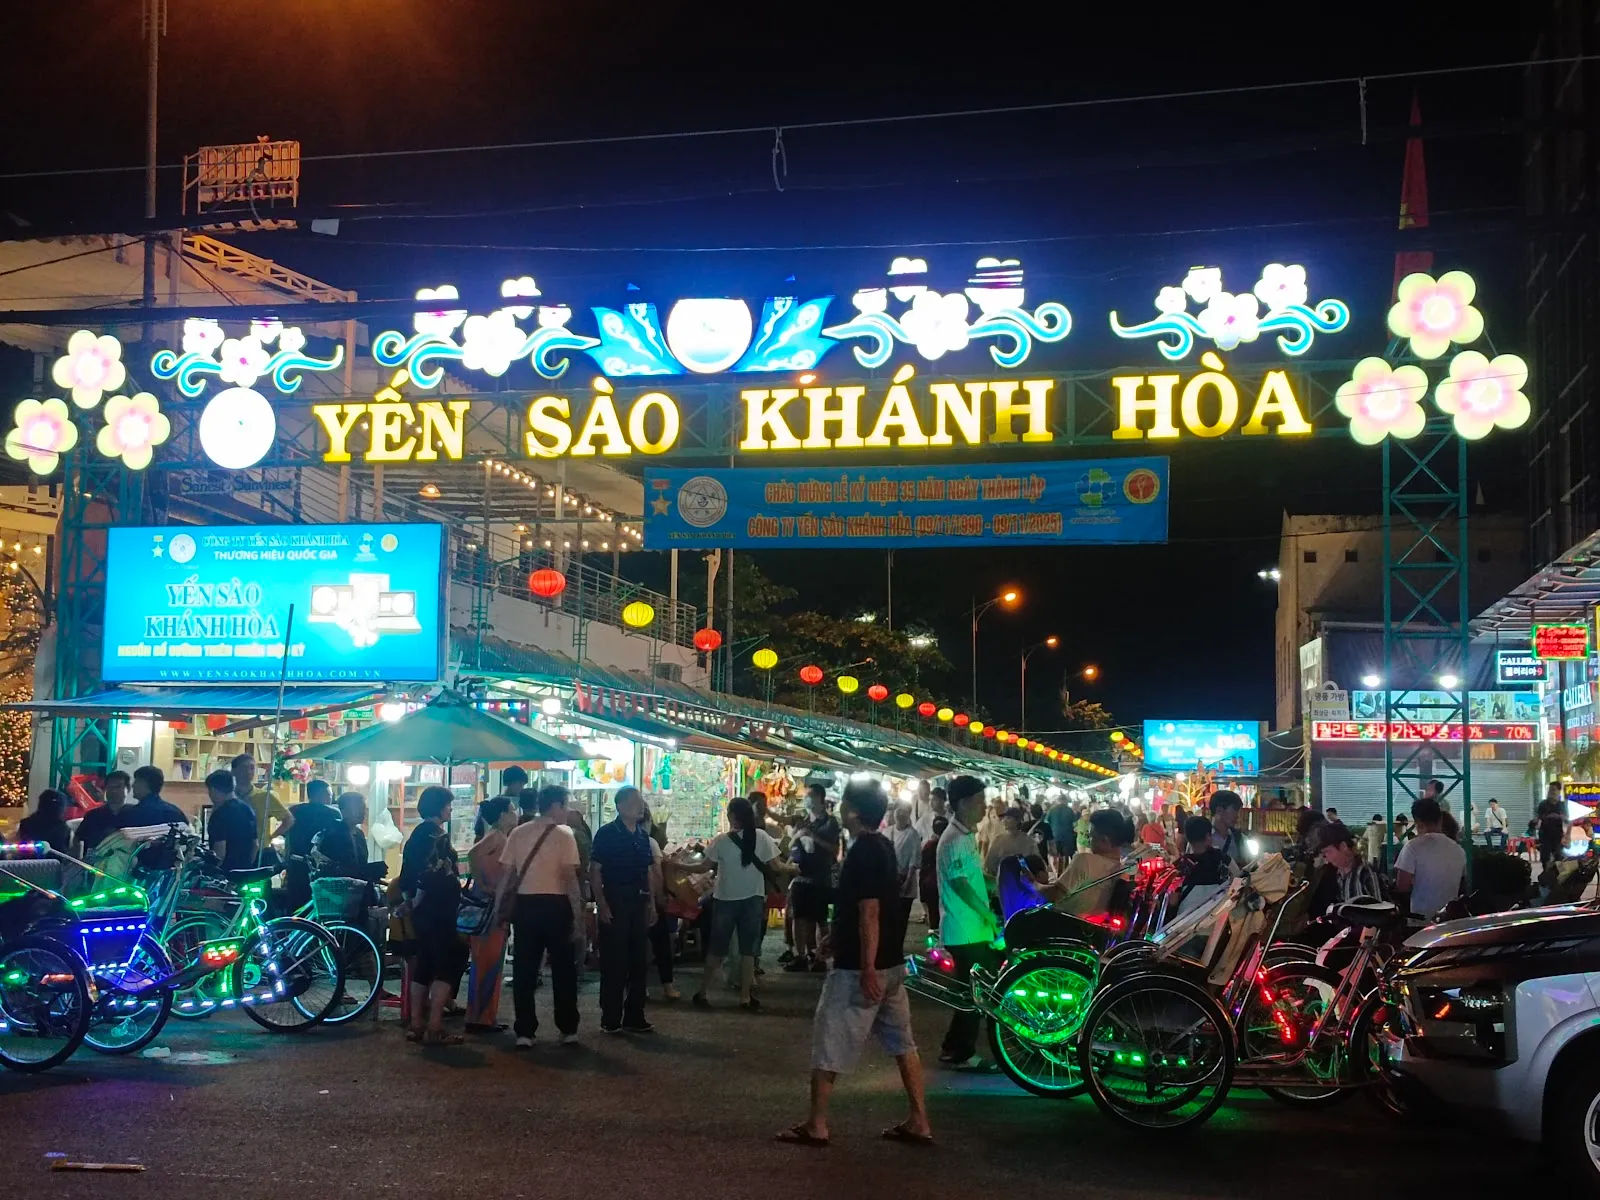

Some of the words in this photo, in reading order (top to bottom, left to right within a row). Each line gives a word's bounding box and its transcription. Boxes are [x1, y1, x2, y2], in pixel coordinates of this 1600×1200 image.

[312, 368, 471, 462] YẾN
[525, 376, 681, 458] SÀO
[738, 364, 1055, 450] KHÁNH
[1110, 351, 1313, 441] HÒA
[764, 479, 795, 504] CHÀO
[798, 480, 832, 504] MỪNG
[833, 472, 848, 503] LỄ
[849, 474, 866, 503] KỶ
[867, 476, 897, 507] NIỆM
[900, 480, 915, 501] 35
[917, 476, 945, 501] NĂM
[947, 475, 979, 501] NGÀY
[981, 474, 1020, 500] THÀNH
[1022, 473, 1046, 503] LẬP
[748, 512, 779, 537] CÔNG
[781, 517, 795, 537] TY
[796, 512, 819, 537] YẾN
[821, 512, 845, 537] SÀO
[847, 512, 887, 537] KHÁNH
[888, 511, 912, 537] HÒA
[915, 513, 984, 538] (09/11/1990
[992, 512, 1064, 537] 09/11/2025)
[202, 533, 230, 547] CÔNG
[232, 536, 245, 547] TY
[214, 550, 258, 561] THƯƠNG
[287, 548, 317, 561] QUỐC
[319, 549, 338, 560] GIA
[165, 573, 212, 607] YẾN
[215, 576, 262, 607] SÀO
[144, 609, 226, 638] KHÁNH
[230, 612, 280, 638] HÒA
[1505, 726, 1532, 739] 70%
